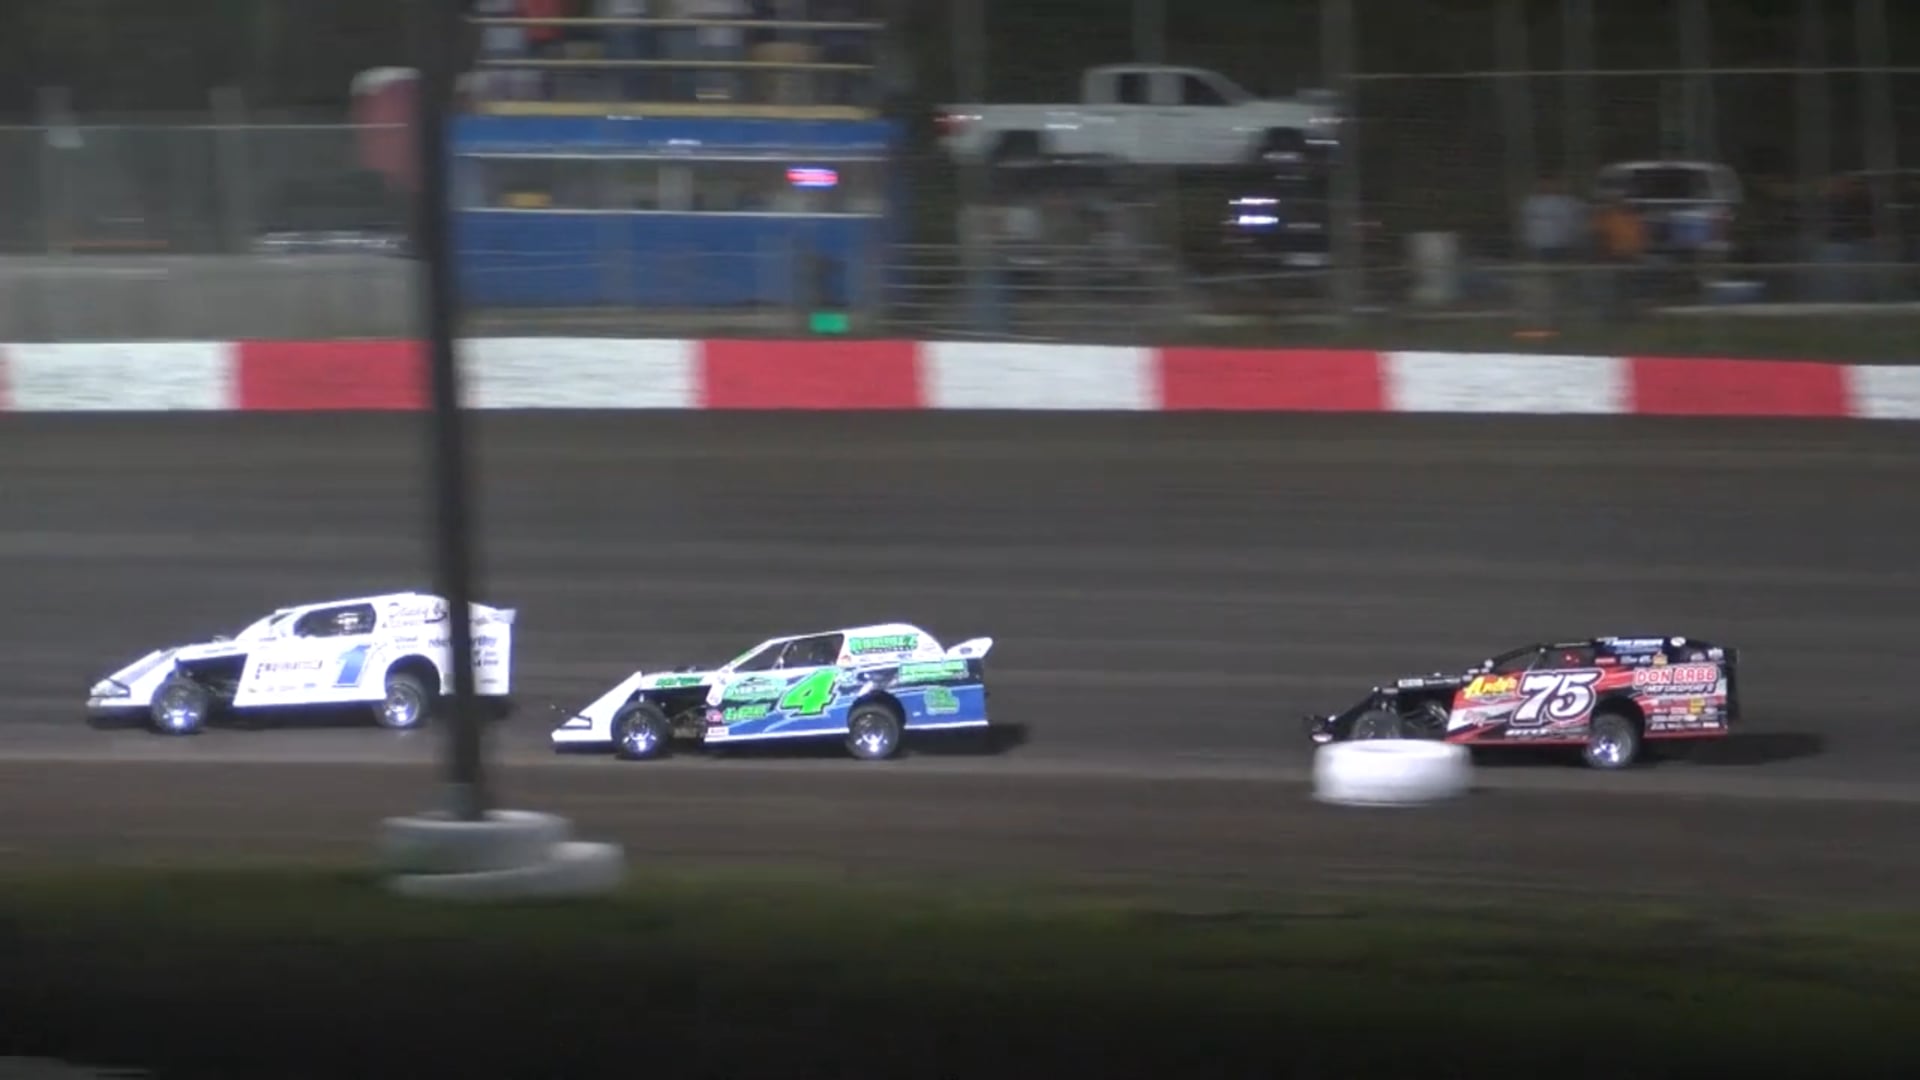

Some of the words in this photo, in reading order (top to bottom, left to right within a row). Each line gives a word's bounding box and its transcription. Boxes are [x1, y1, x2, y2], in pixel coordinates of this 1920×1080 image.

[333, 644, 372, 688] 1
[1635, 668, 1673, 686] DON
[1674, 665, 1718, 683] BABB
[781, 667, 838, 717] 4
[1512, 670, 1602, 724] 75
